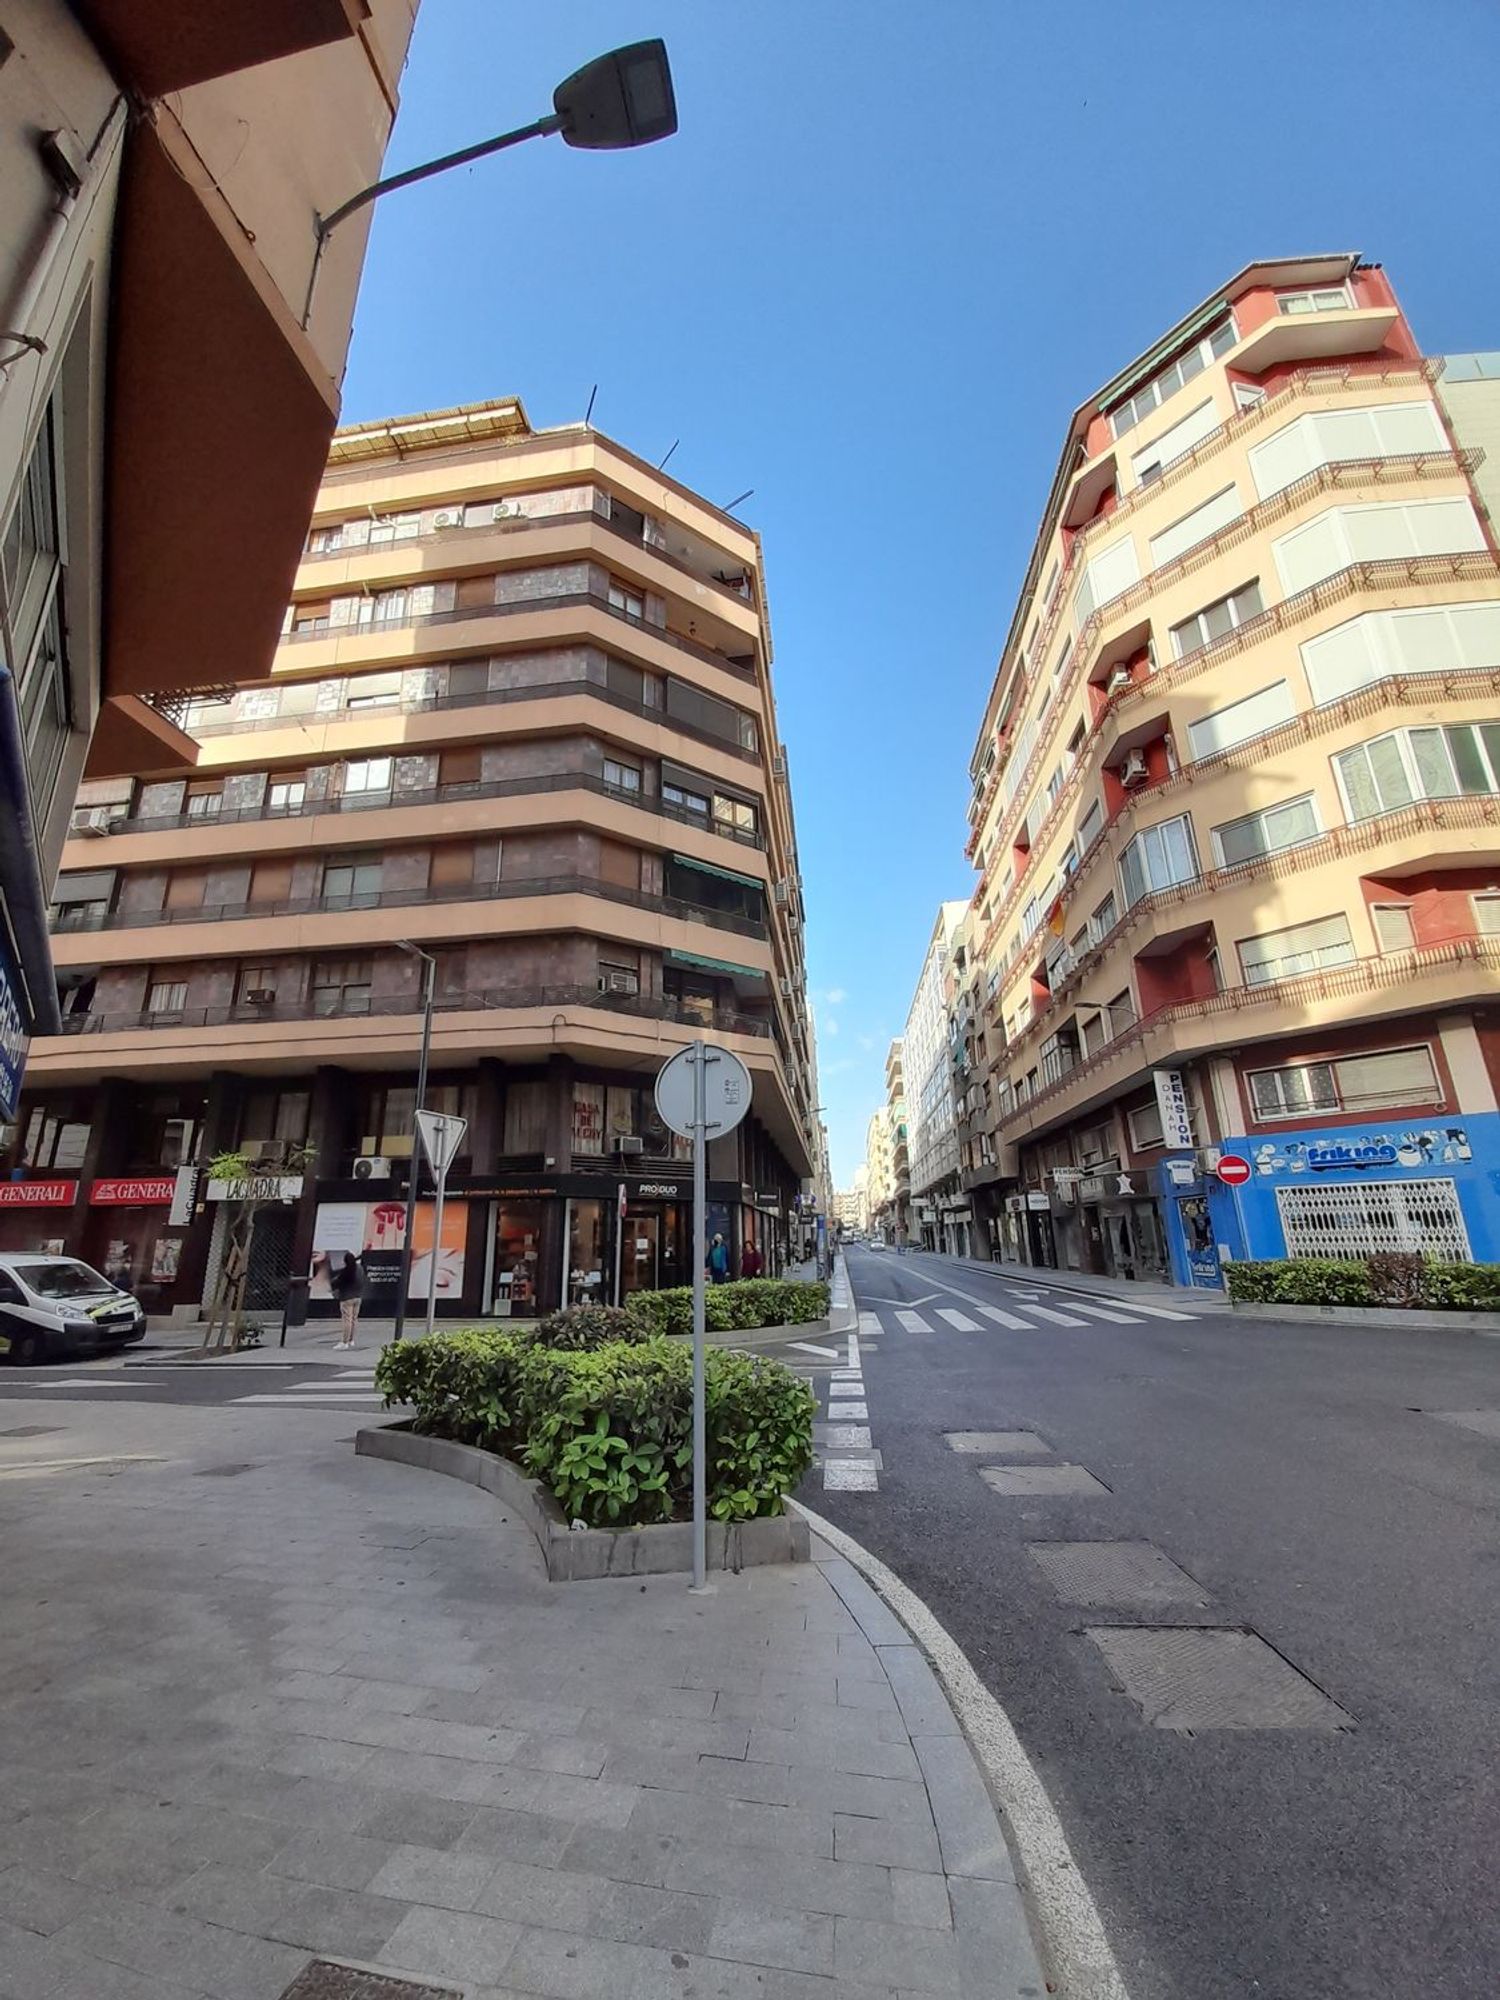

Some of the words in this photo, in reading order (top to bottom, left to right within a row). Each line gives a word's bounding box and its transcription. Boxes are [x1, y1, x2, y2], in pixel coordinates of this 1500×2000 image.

[1169, 1074, 1190, 1144] PENSION
[1, 1185, 65, 1201] GENERALI
[117, 1182, 174, 1199] GENERA
